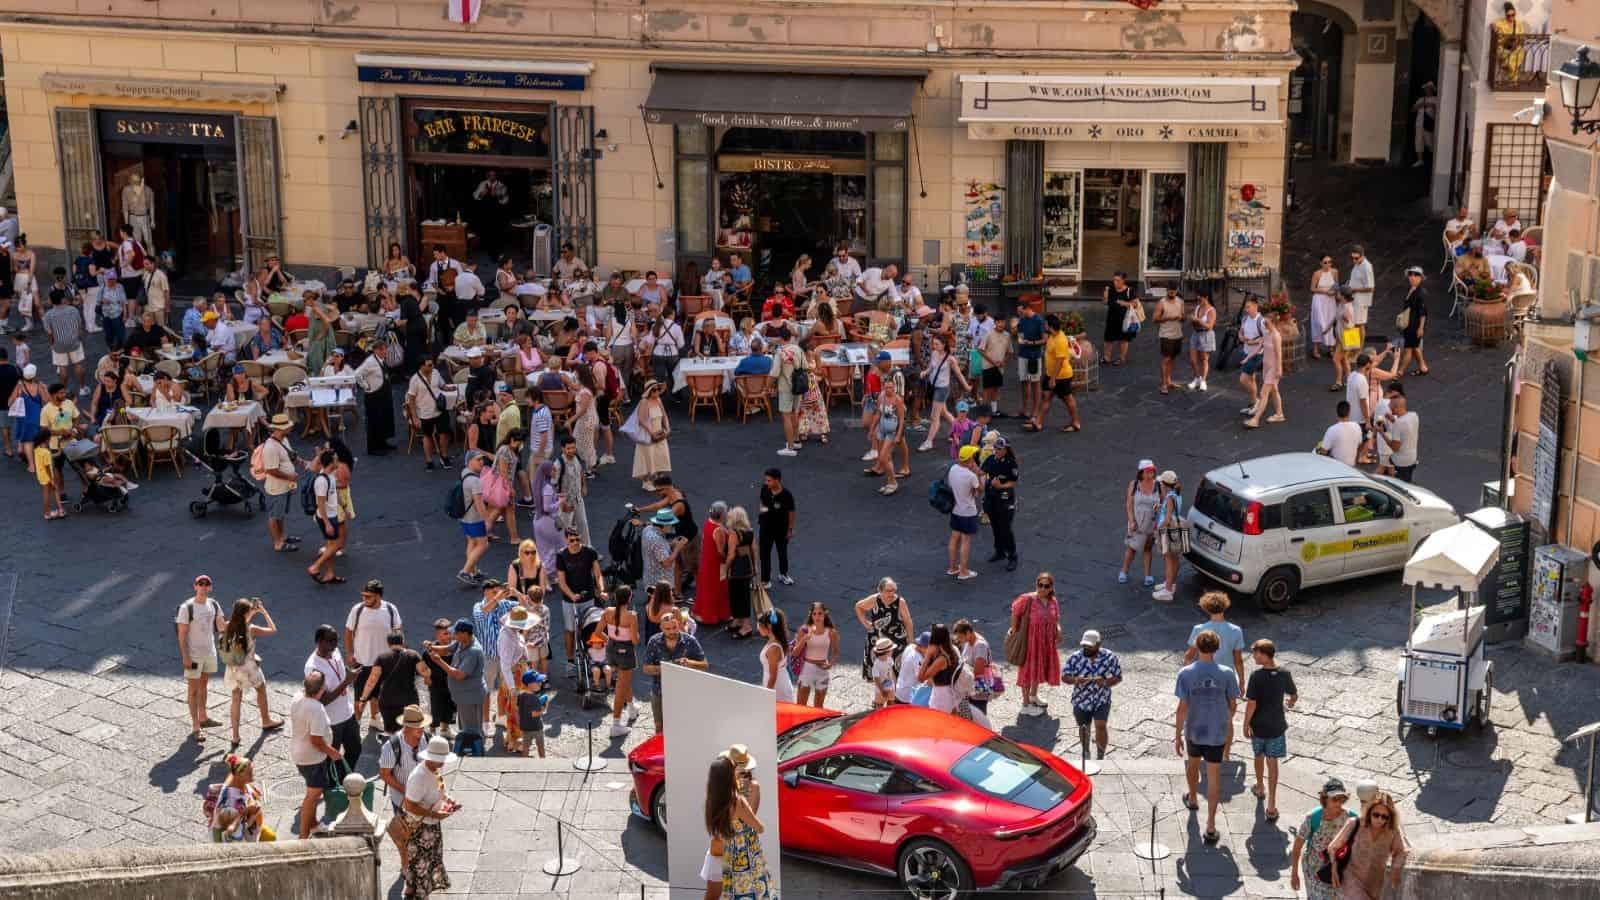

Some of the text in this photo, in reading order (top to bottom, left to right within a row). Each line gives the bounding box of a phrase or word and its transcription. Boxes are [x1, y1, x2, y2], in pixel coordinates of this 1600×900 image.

[424, 115, 536, 142] BAR FRANCESE
[1013, 127, 1238, 138] CORALLO ORO CAMMEI
